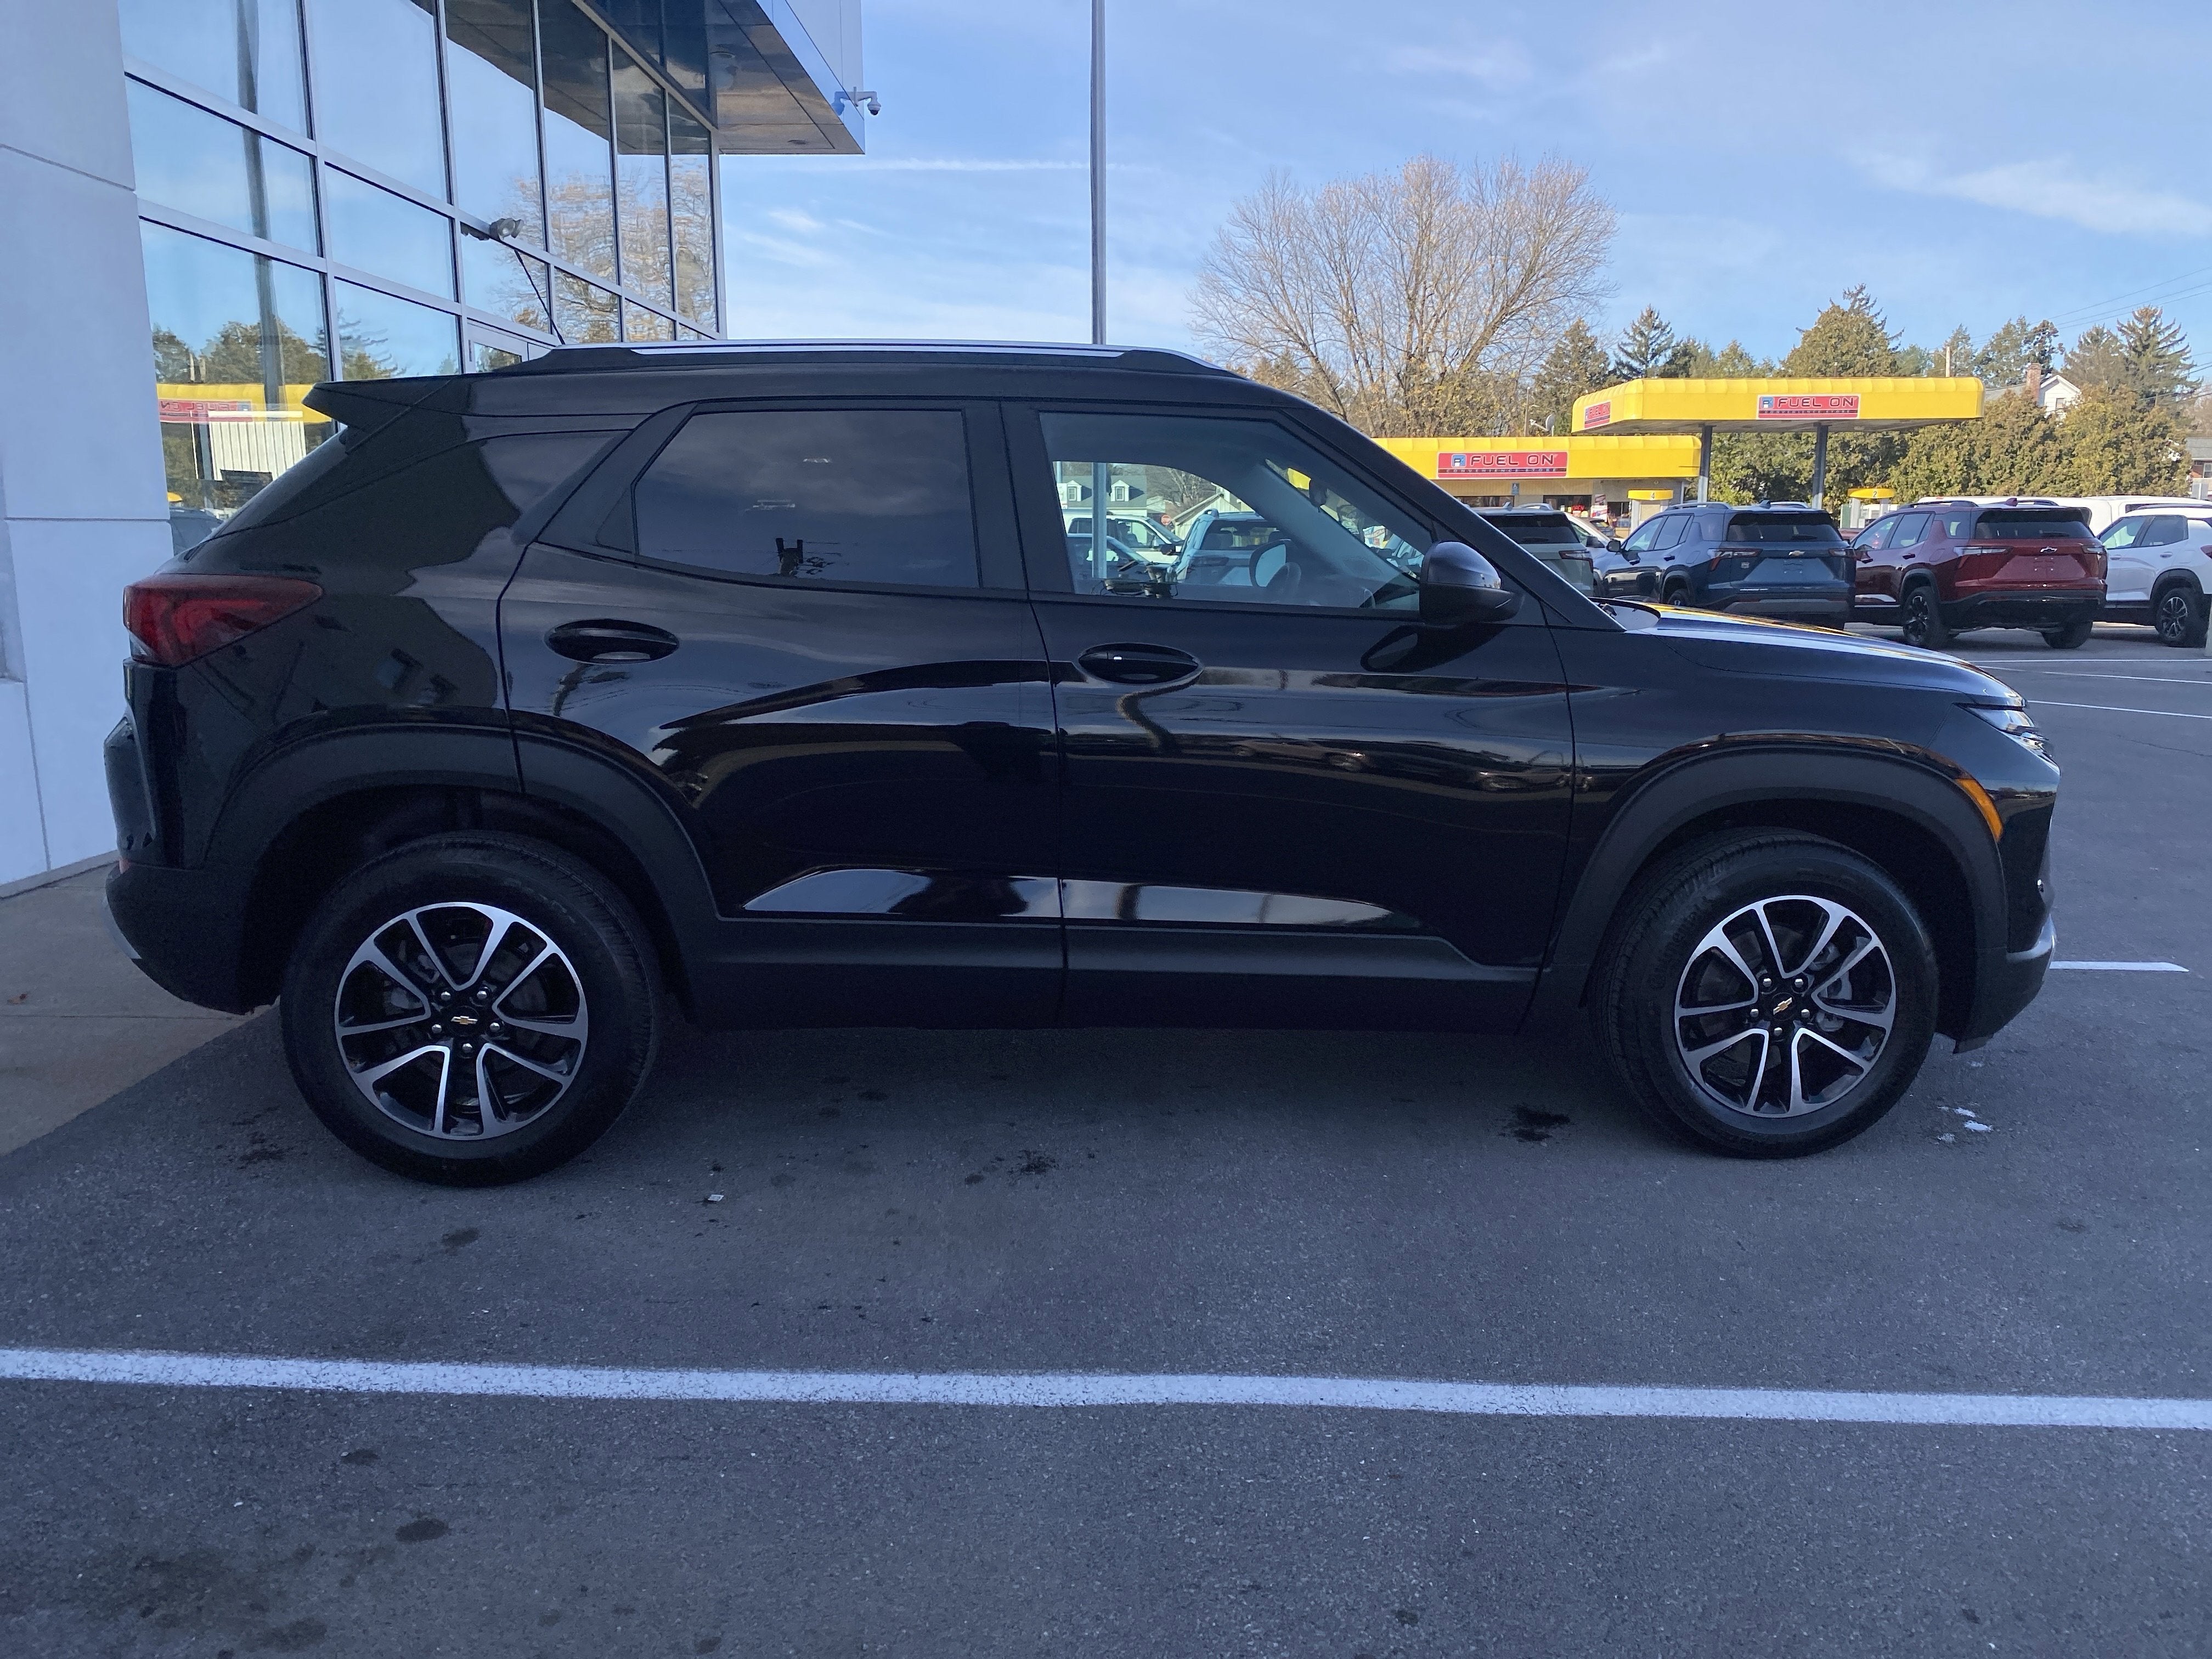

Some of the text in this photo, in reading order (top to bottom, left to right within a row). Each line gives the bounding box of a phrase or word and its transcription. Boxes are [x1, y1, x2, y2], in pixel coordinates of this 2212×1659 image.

[1778, 397, 1853, 407] FUEL ON
[1470, 454, 1554, 466] FUEL ON
